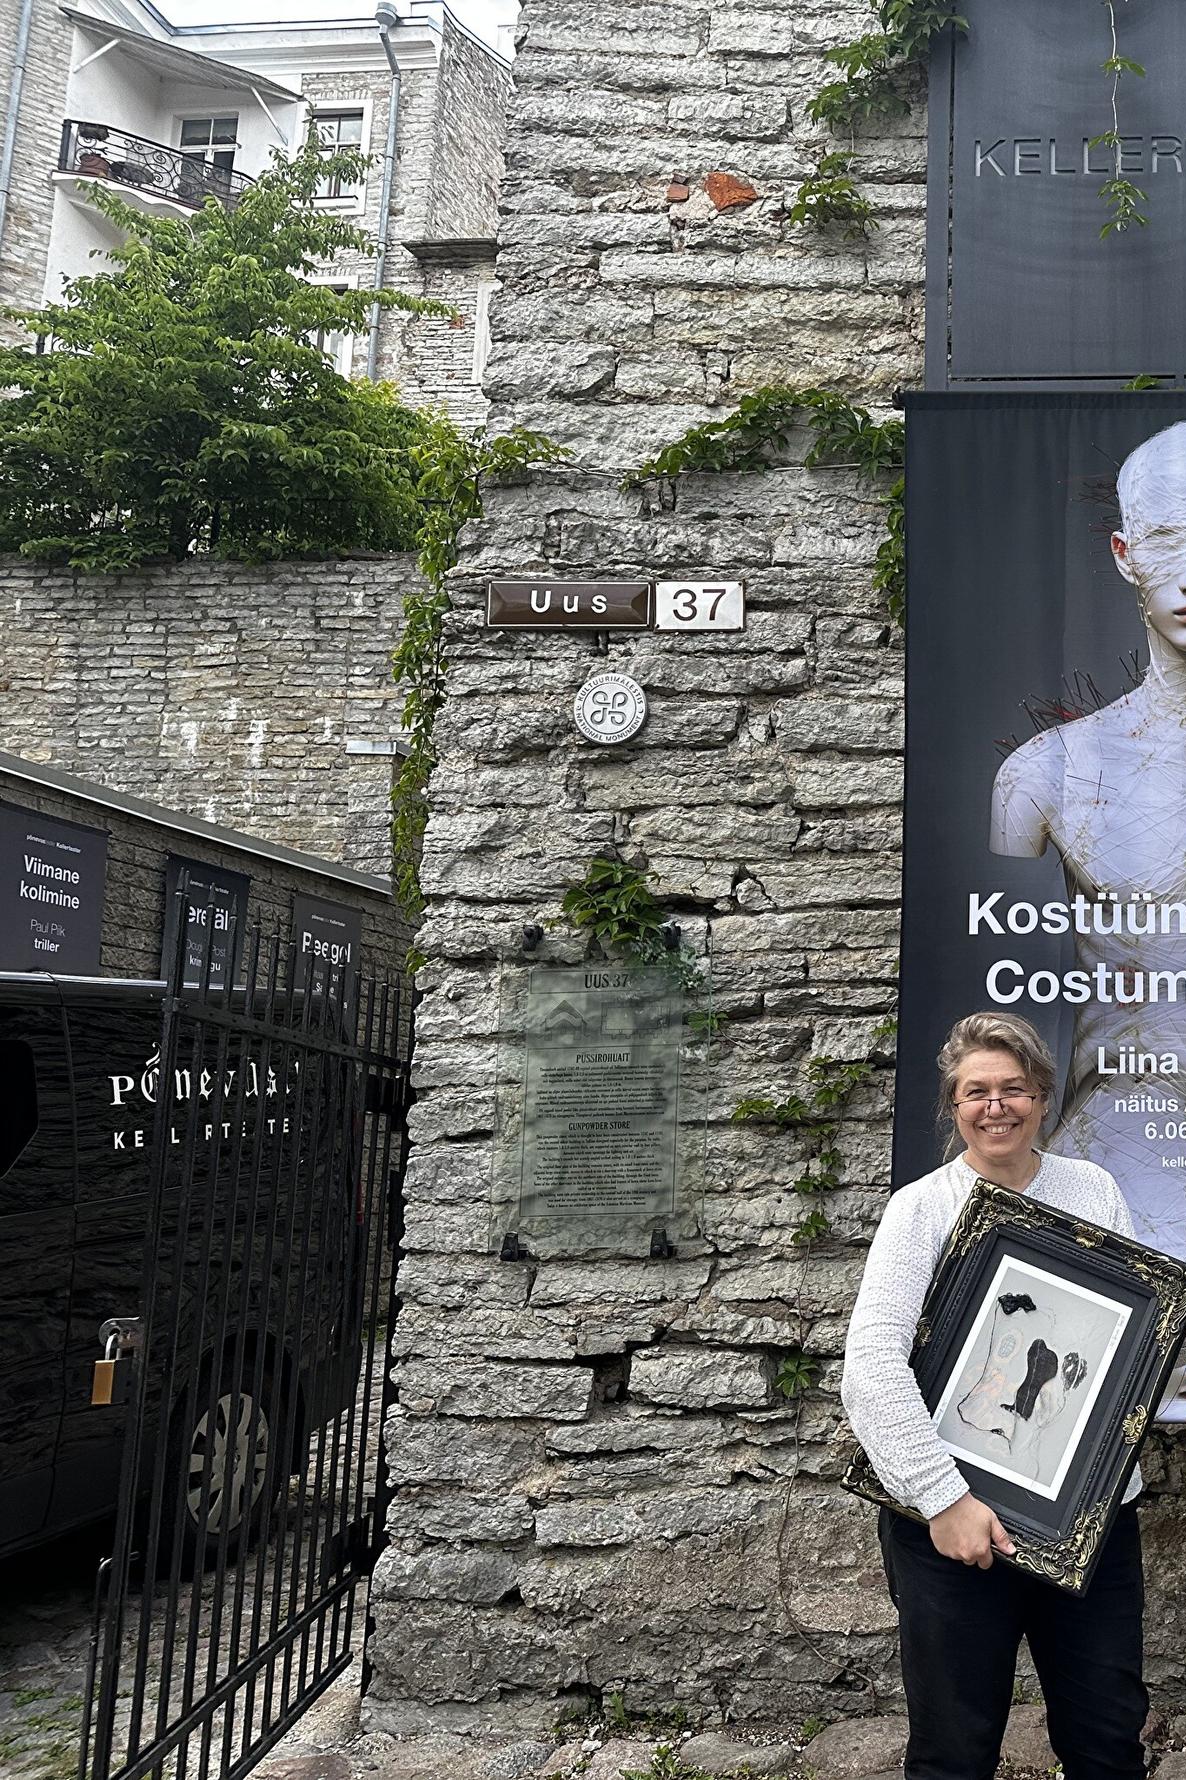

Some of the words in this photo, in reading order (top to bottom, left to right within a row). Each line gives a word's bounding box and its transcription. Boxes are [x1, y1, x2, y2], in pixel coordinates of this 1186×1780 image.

[531, 590, 608, 613] Uus
[672, 588, 727, 621] 37
[24, 854, 80, 884] Viimane
[20, 880, 80, 909] kolimine
[34, 938, 60, 953] triller
[584, 974, 610, 989] UUS
[613, 973, 630, 988] 37
[1097, 1045, 1179, 1075] Liina
[1114, 1094, 1179, 1113] näitus
[568, 1121, 609, 1131] GUNPOWDER
[609, 1120, 631, 1130] STORE
